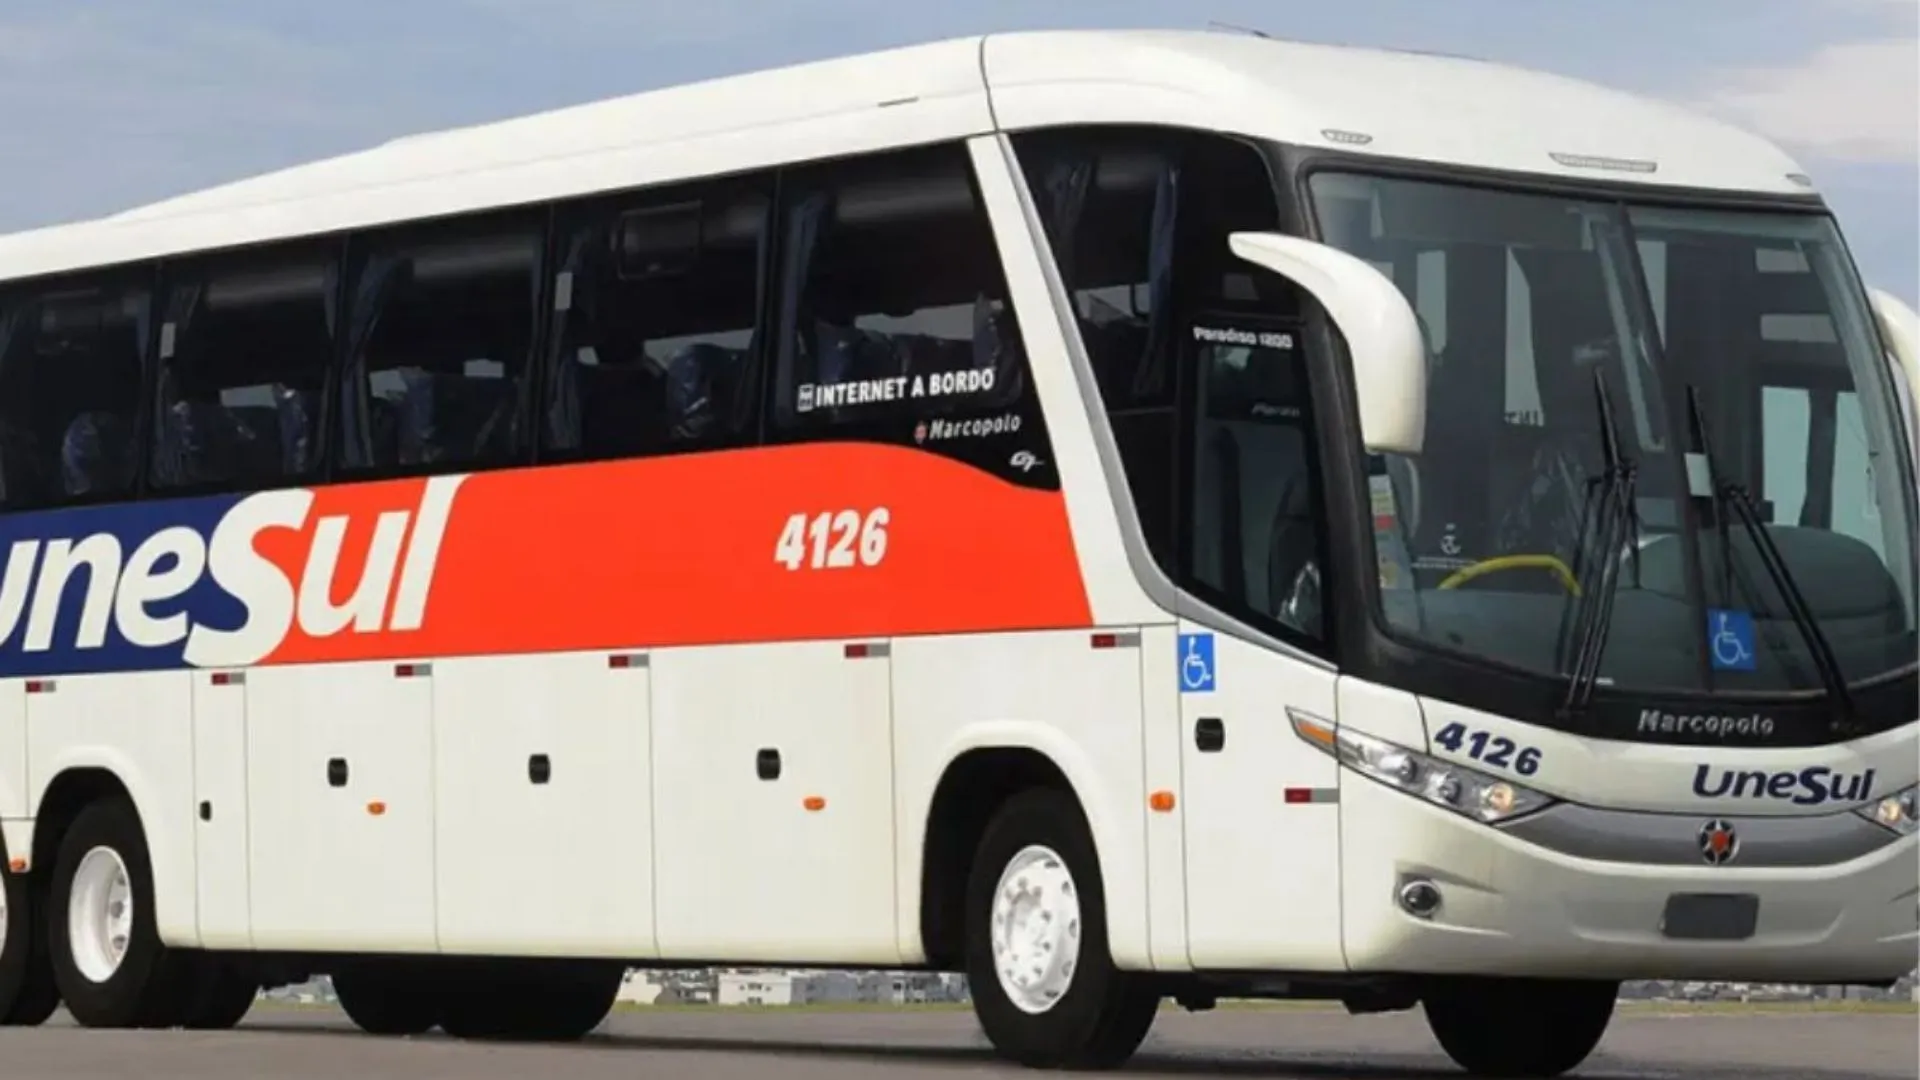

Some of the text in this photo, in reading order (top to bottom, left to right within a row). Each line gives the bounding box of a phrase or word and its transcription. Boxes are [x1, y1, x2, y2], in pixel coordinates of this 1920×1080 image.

[816, 366, 996, 408] INTERNET A BORDO
[929, 413, 1022, 440] Marcopolo
[774, 506, 890, 570] 4126
[1637, 709, 1774, 735] Marcopolo
[1434, 722, 1542, 776] 4126
[1693, 764, 1875, 804] UneSul
